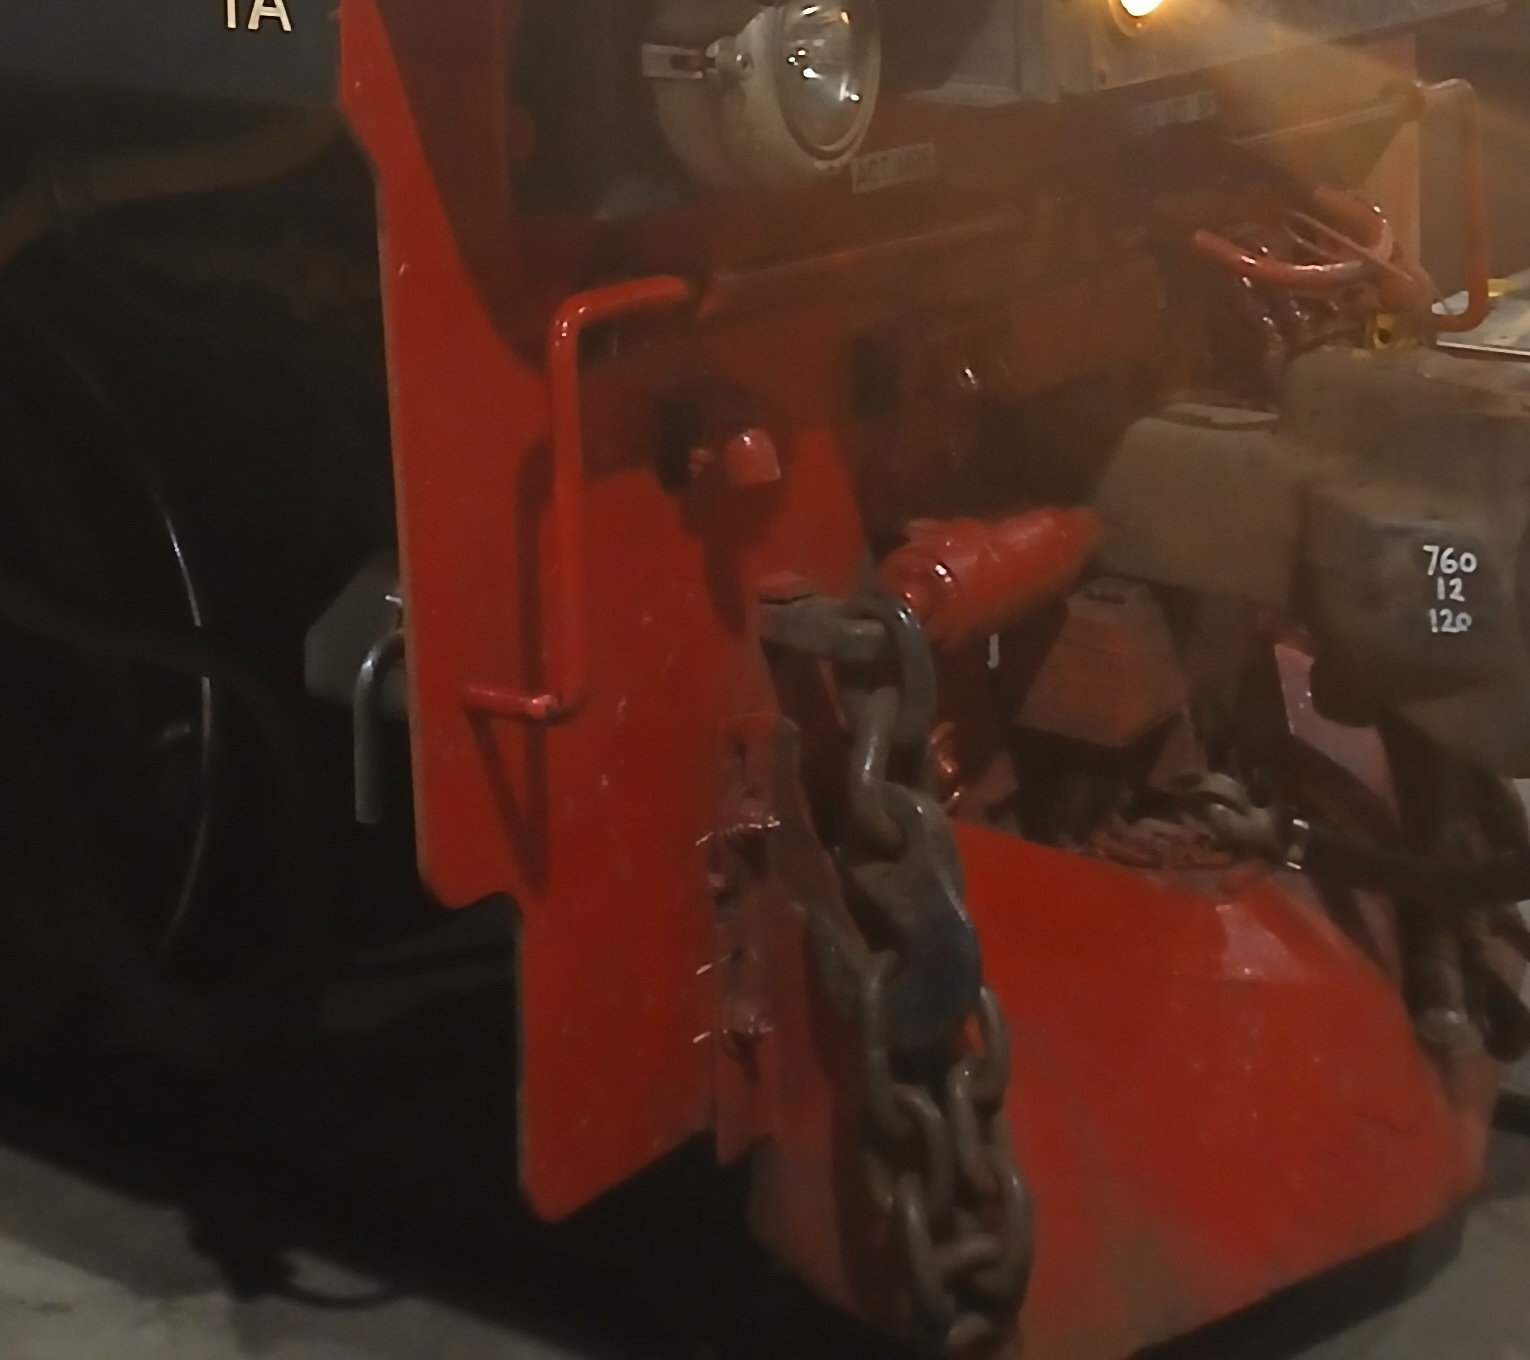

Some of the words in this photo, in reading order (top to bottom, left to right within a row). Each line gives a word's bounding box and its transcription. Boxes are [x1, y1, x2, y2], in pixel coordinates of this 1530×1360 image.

[1422, 544, 1478, 576] 760
[1436, 576, 1466, 603] 12
[1428, 608, 1472, 633] 120
